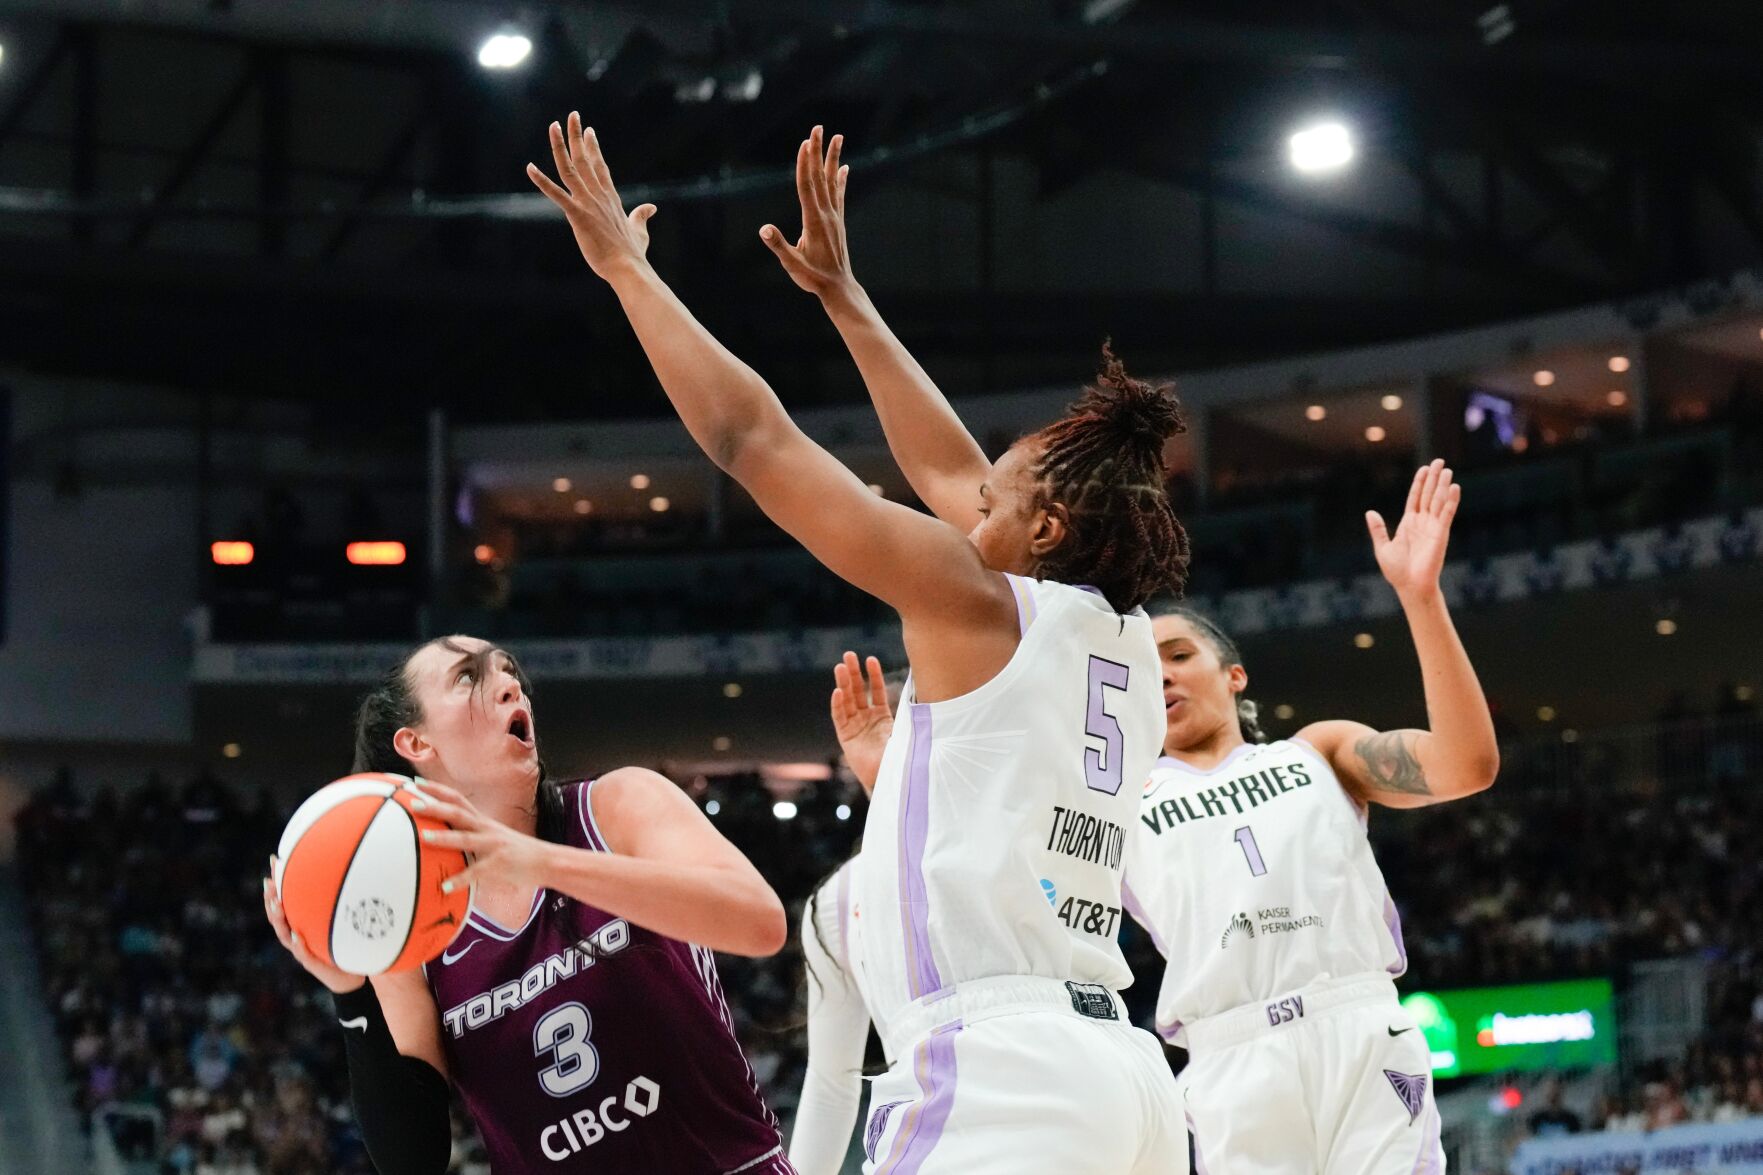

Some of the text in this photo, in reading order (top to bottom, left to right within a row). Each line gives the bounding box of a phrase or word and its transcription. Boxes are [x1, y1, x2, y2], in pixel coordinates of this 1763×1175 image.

[1084, 654, 1130, 796] 5
[1141, 763, 1312, 836] VALKYRIES
[1047, 806, 1127, 872] THORNTON
[1234, 825, 1268, 877] 1
[1057, 896, 1121, 938] AT&T
[1258, 907, 1291, 920] KAISER
[1261, 915, 1324, 935] PERMANENTE
[443, 917, 631, 1039] TORONTO
[1265, 995, 1305, 1027] GSV
[532, 1000, 601, 1099] 3
[540, 1096, 631, 1162] CIBC
